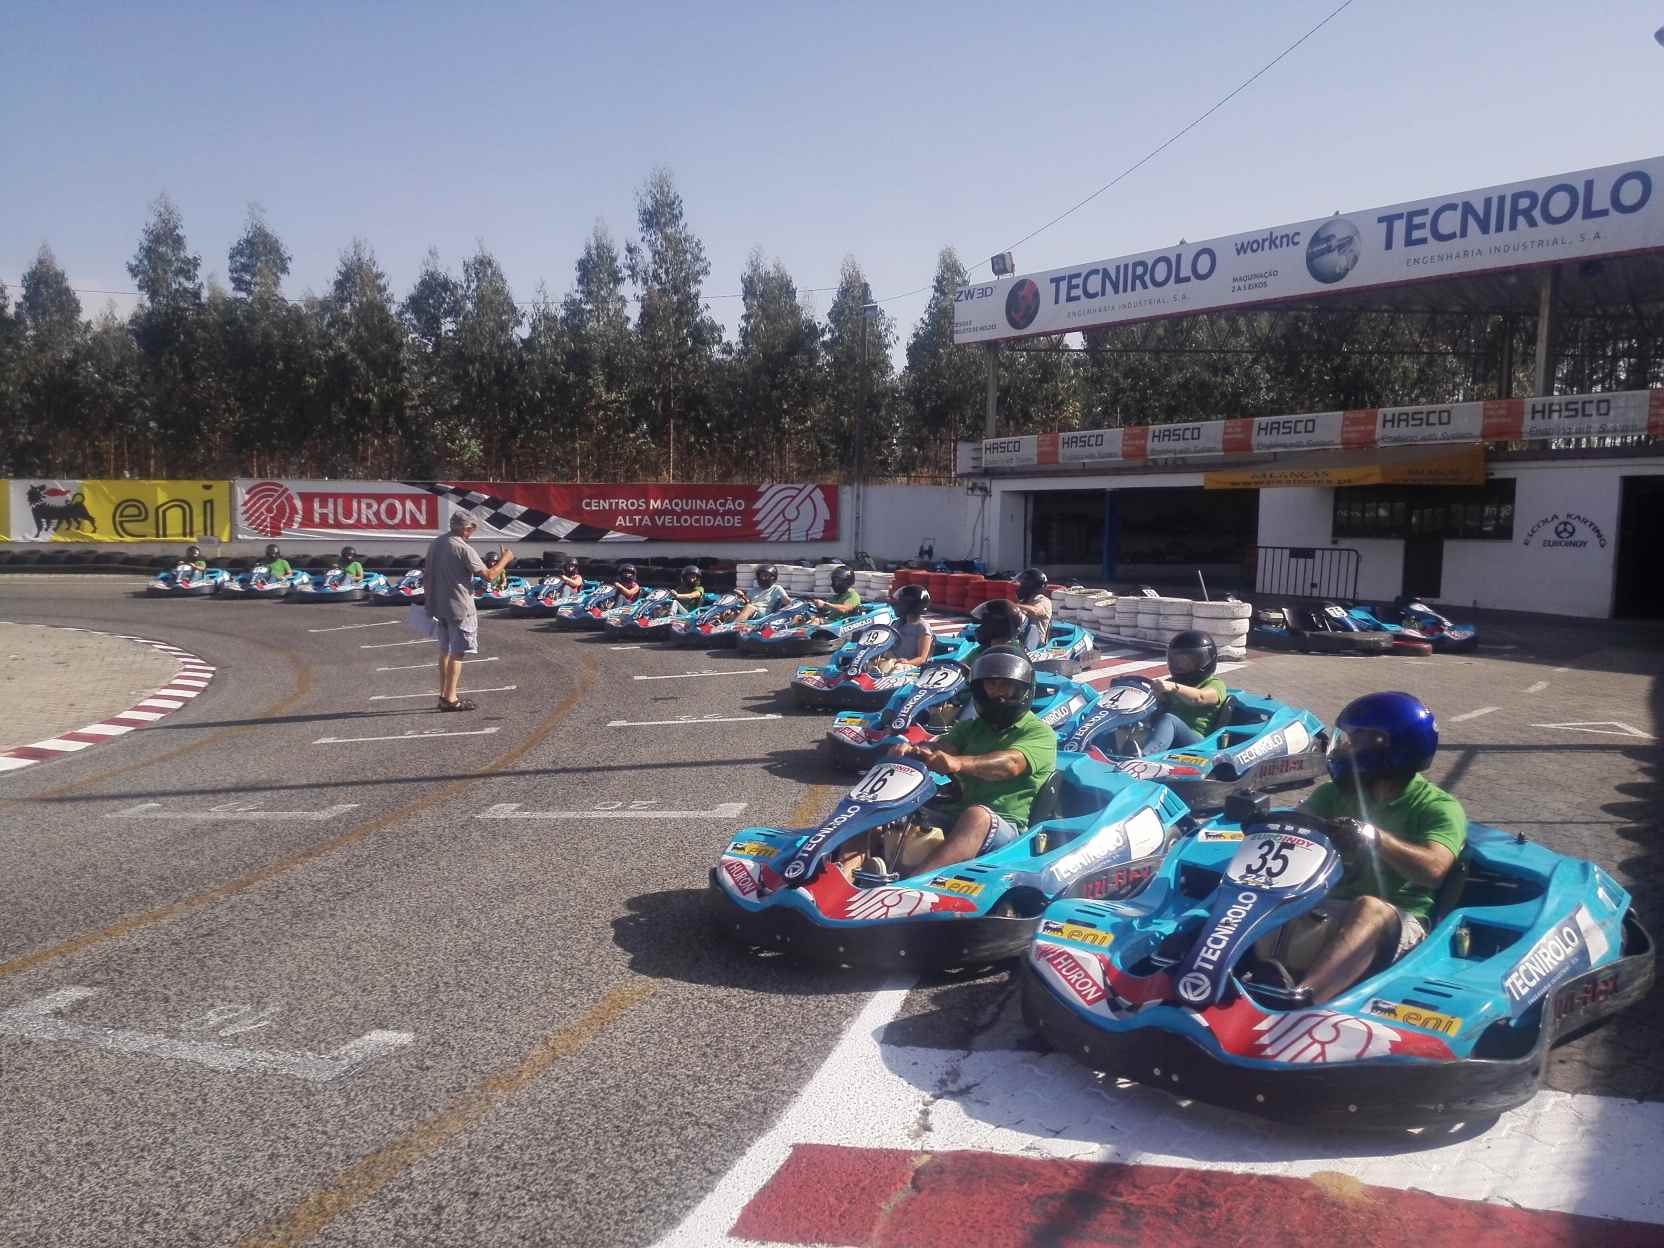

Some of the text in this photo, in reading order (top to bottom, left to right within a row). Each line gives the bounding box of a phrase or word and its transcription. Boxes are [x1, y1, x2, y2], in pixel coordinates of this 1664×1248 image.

[1377, 170, 1653, 251] TECNIROLO
[1234, 231, 1301, 256] worknc
[1406, 249, 1482, 267] ENGENHARIA
[1050, 247, 1217, 305] TECNIROLO
[1382, 409, 1451, 429] HASCO
[1531, 399, 1611, 420] HASCO
[1152, 426, 1201, 443] HASCO
[1257, 418, 1316, 436] HASCO
[984, 439, 1021, 454] HASCO
[1062, 433, 1104, 449] HASCO
[112, 484, 214, 538] eni
[313, 498, 428, 526] HURON
[582, 496, 745, 513] CENTROS MAQUINAÇÃO
[615, 515, 743, 528] ALTA VELOCIDADE
[926, 671, 949, 686] 12
[859, 766, 895, 795] 16
[1245, 839, 1296, 877] 35
[727, 861, 756, 894] HURON
[1067, 929, 1109, 945] eni
[1192, 891, 1257, 970] TECNIROLO
[1504, 926, 1579, 1001] TECNIROLO
[1052, 953, 1102, 1001] HURON
[1402, 1011, 1457, 1033] eni
